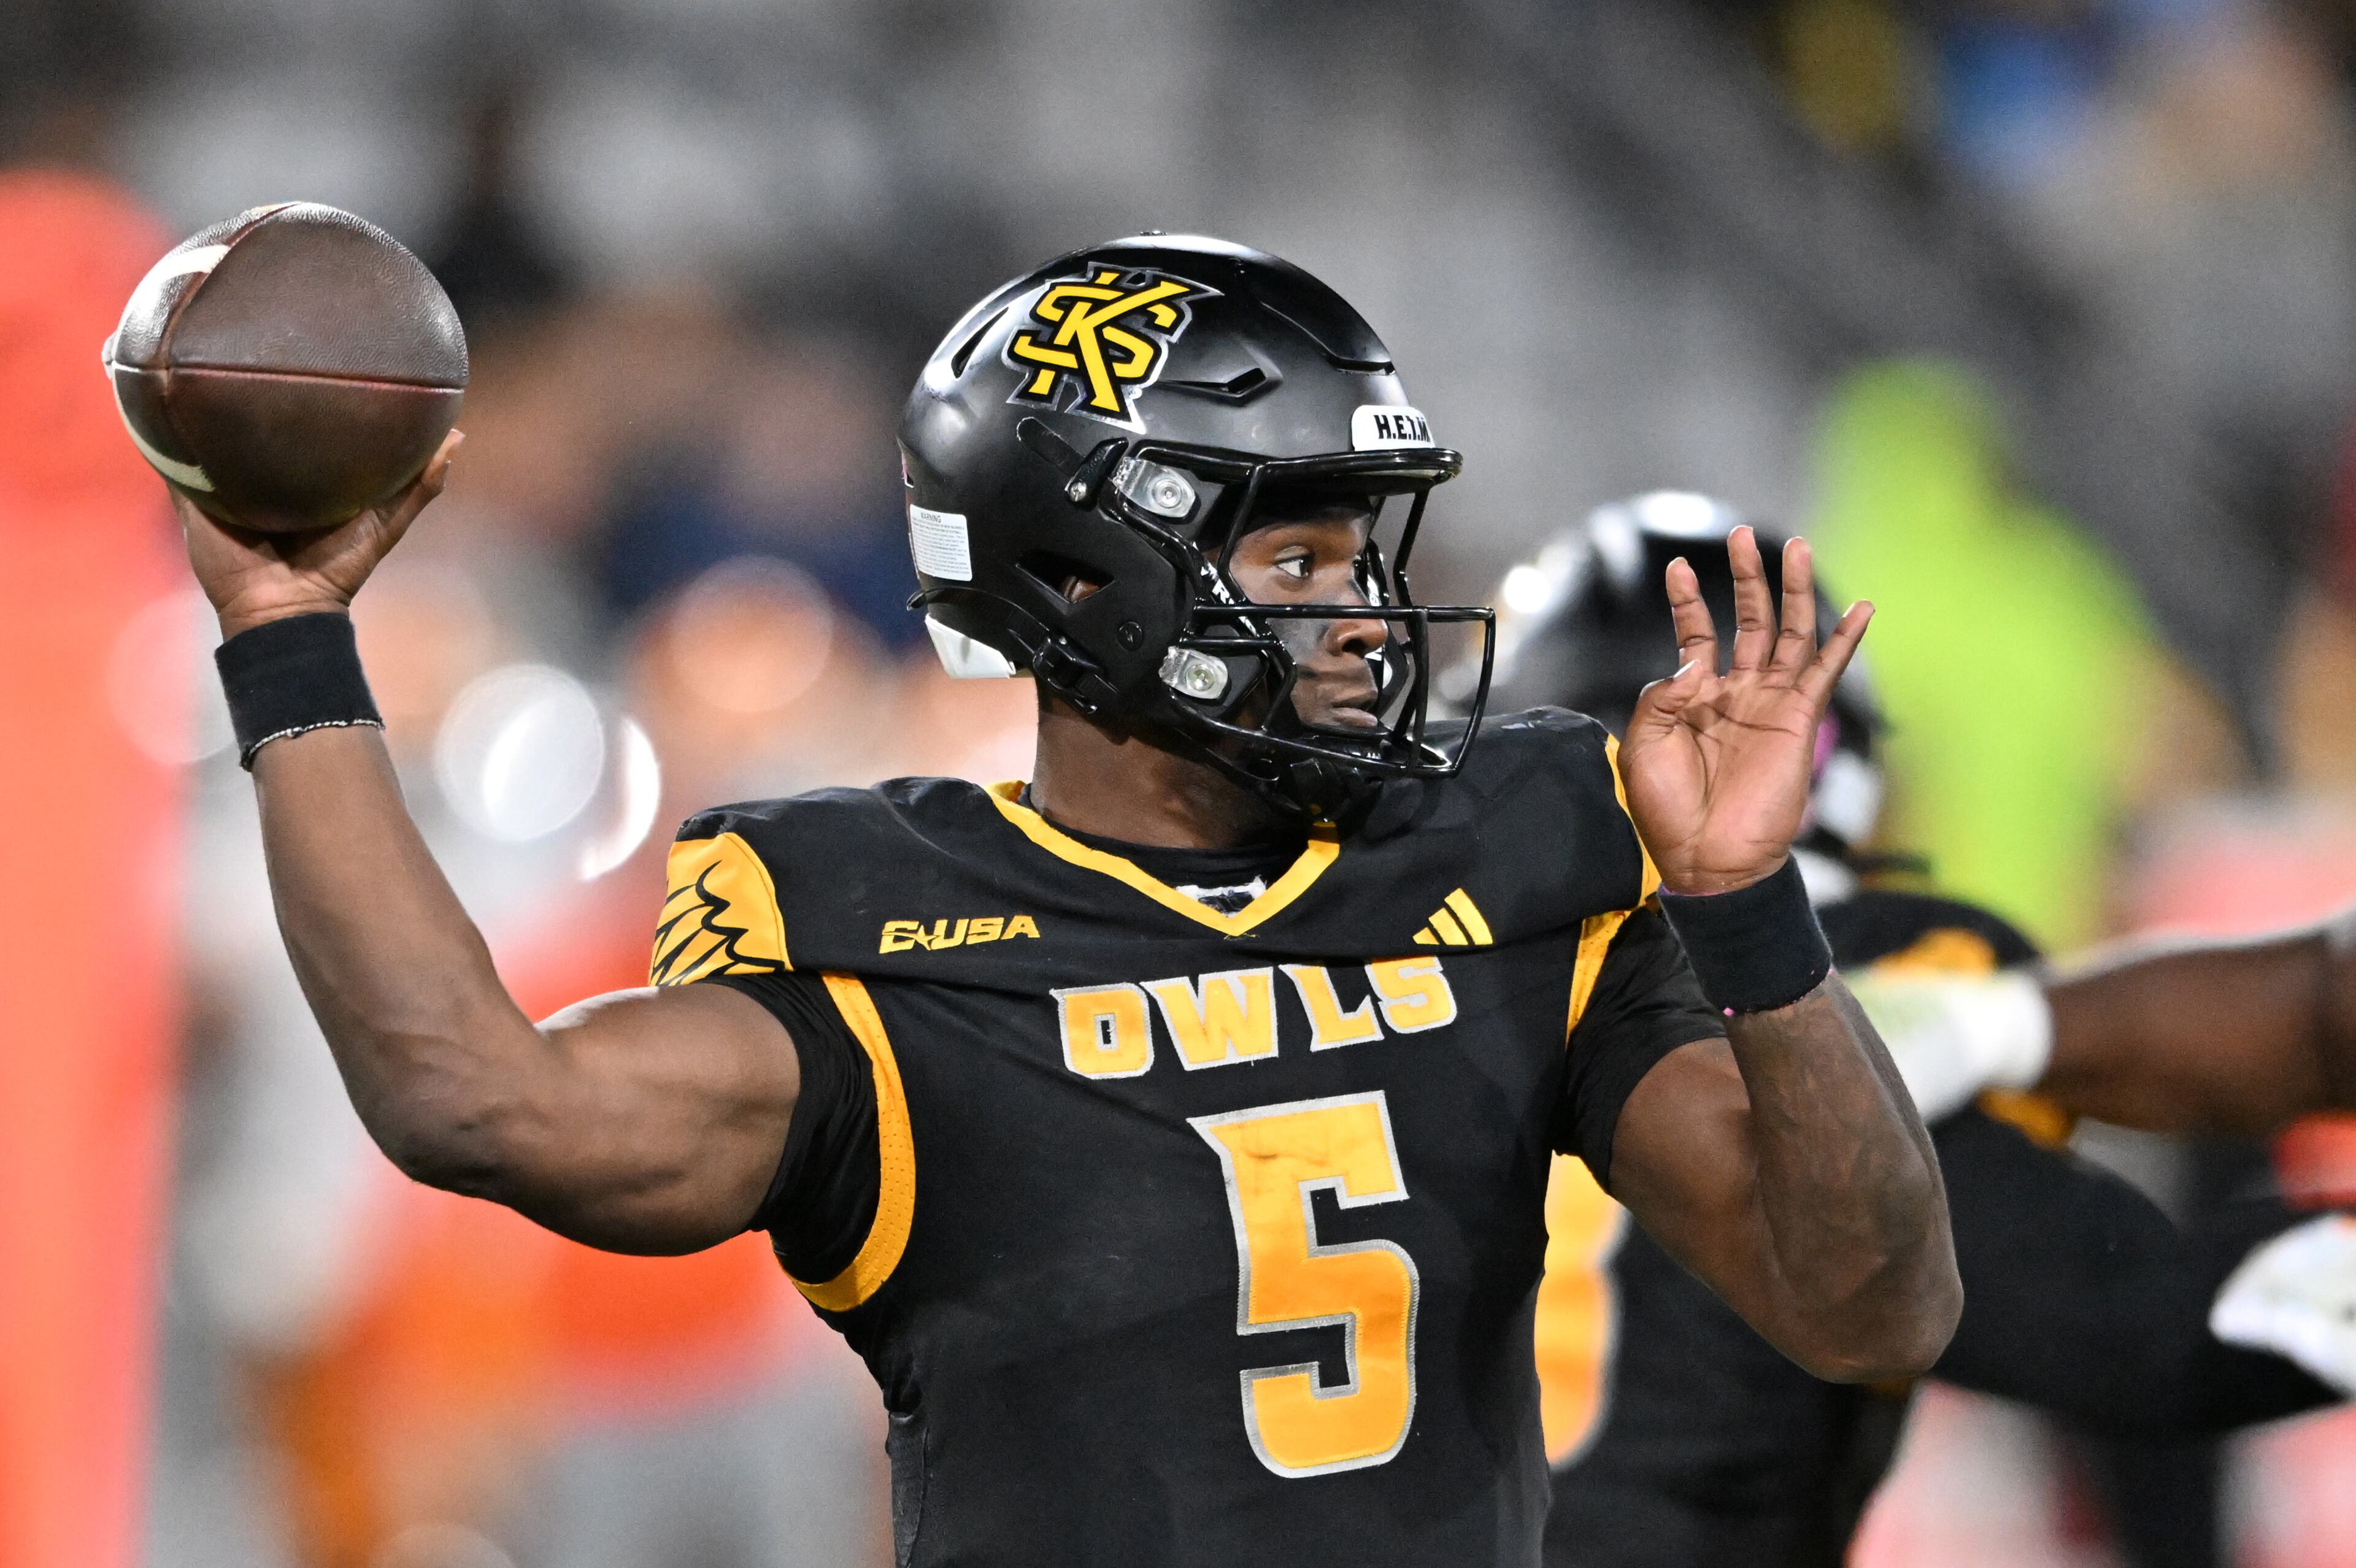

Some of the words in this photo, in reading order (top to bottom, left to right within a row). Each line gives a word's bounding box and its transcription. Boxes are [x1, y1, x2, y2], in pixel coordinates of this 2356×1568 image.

[921, 513, 941, 523] WARNING
[1050, 956, 1458, 1080] OWLS
[1187, 1091, 1420, 1478] 5
